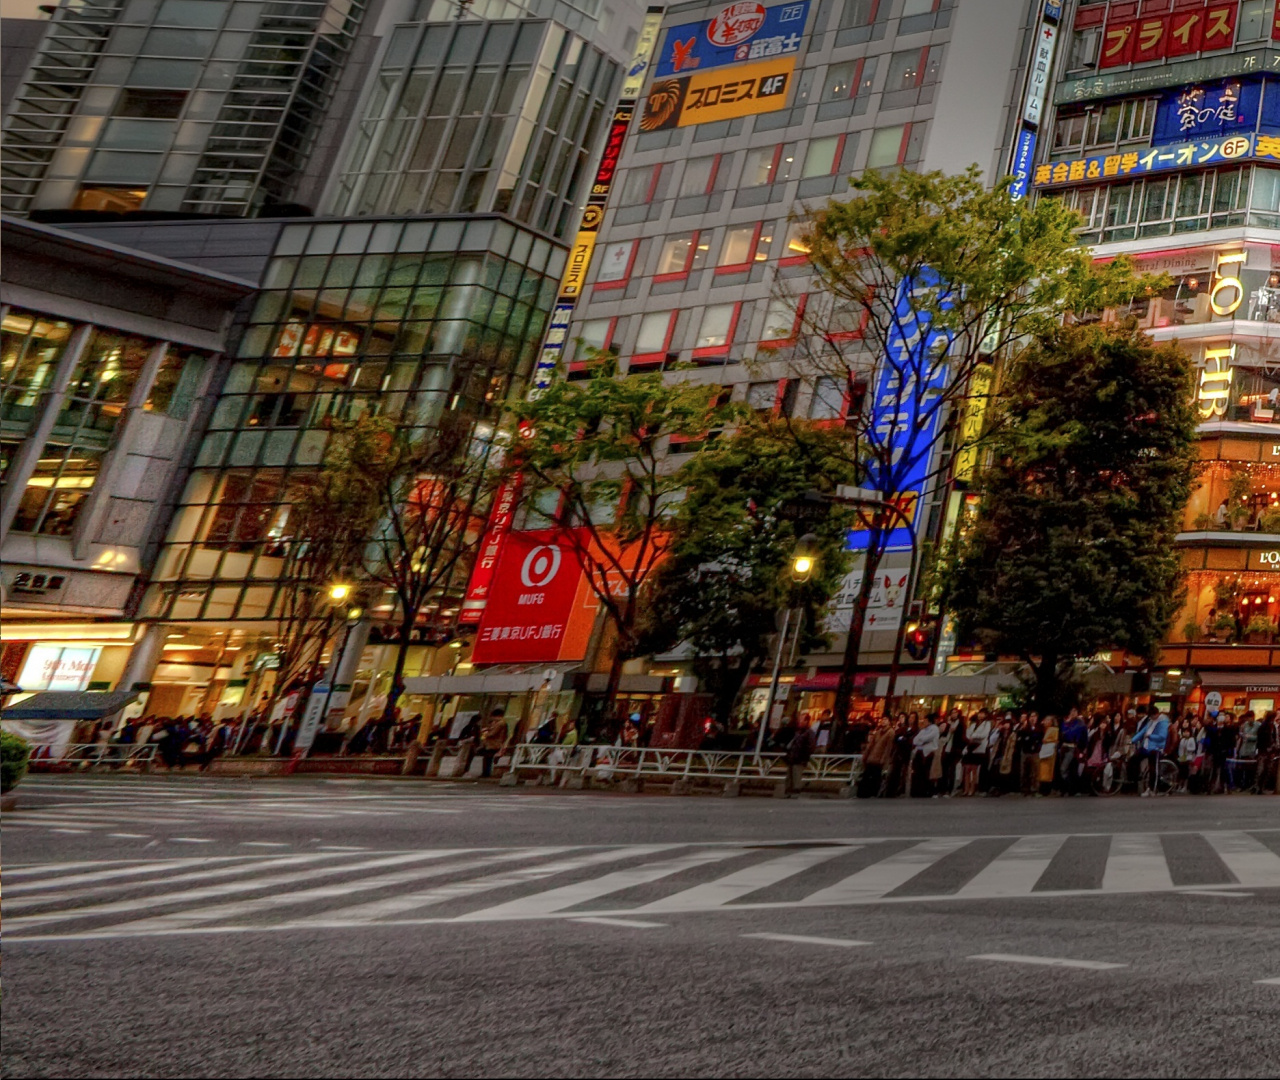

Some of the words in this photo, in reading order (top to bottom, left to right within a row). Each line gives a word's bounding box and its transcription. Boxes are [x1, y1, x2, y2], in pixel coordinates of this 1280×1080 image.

[783, 9, 800, 19] 7F
[1106, 9, 1231, 57] プライス
[749, 33, 800, 59] 武富士
[1244, 56, 1256, 68] 7F
[1029, 48, 1049, 110] 献血ルーム
[686, 79, 756, 110] プロミス
[762, 76, 785, 94] 4F
[1224, 141, 1245, 155] 6F
[568, 245, 588, 283] プロミス
[1163, 255, 1197, 270] Dining
[518, 593, 545, 605] MUFG
[480, 623, 563, 642] 三菱東京UFJ銀行
